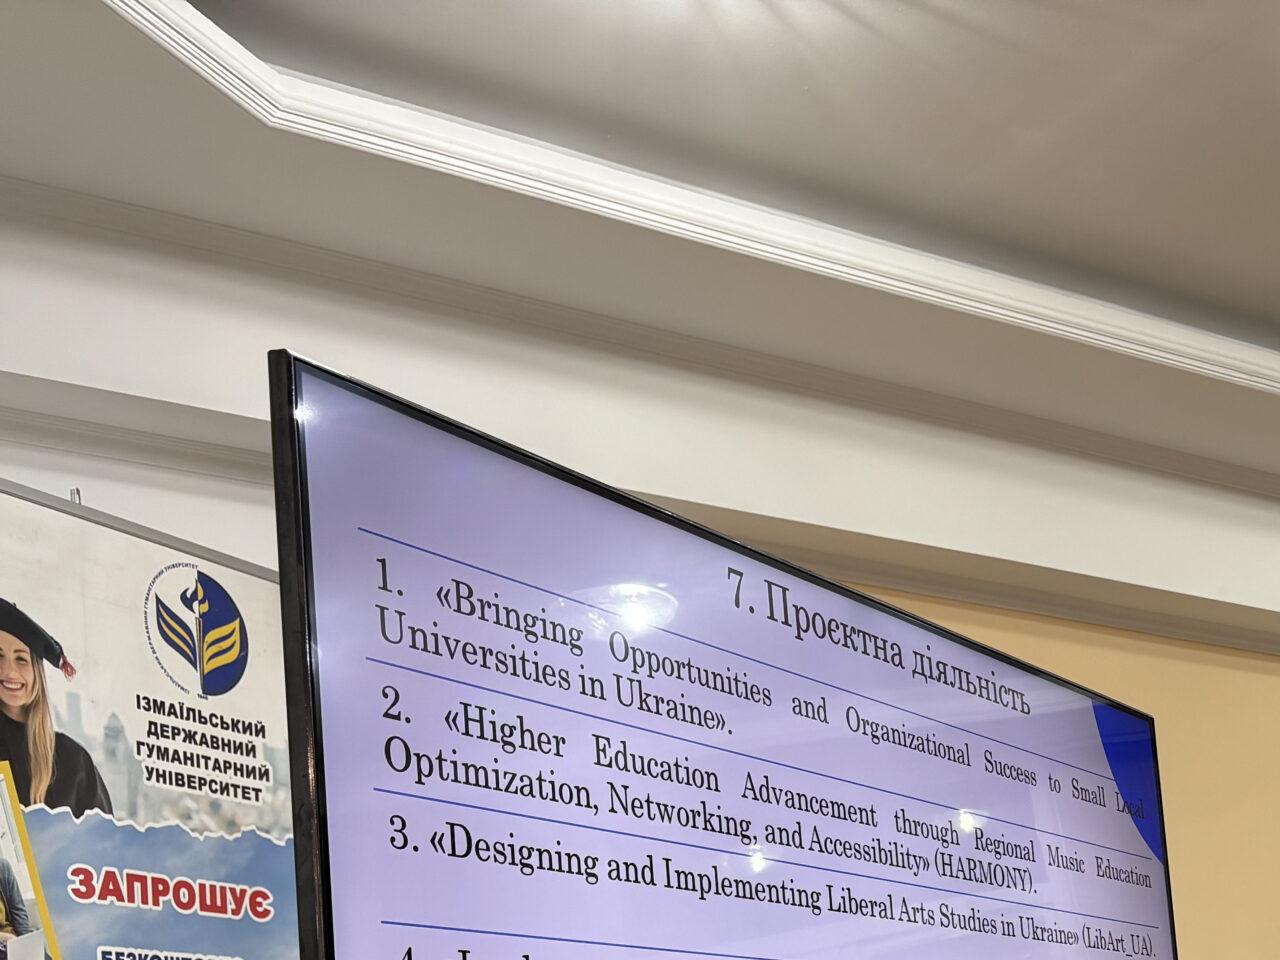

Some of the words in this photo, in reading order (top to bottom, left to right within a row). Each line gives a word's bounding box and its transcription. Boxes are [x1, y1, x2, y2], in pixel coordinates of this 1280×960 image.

[376, 604, 571, 691] Universities
[579, 664, 607, 701] in
[613, 672, 733, 735] Ukraine».
[376, 558, 404, 596] 1.
[436, 578, 584, 656] «Bringing
[609, 630, 773, 707] Opportunities
[791, 695, 829, 725] and
[846, 704, 971, 768] Organizational
[984, 749, 1037, 787] Success
[1048, 772, 1061, 794] to
[1071, 778, 1106, 808] Small
[1115, 792, 1145, 819] Local
[727, 566, 755, 614] 7.
[764, 579, 905, 671] Проєктна
[911, 644, 1031, 716] діяльність
[135, 694, 267, 739] ІЗМАЇЛЬСЬКИЙ
[135, 741, 271, 783] ГУМАНІТАРНИЙ
[146, 719, 257, 759] ДЕРЖАВНИЙ
[143, 764, 263, 802] УНІВЕРСИТЕТ
[382, 685, 412, 724] 2.
[444, 701, 566, 758] «Higher
[592, 733, 721, 793] Education
[741, 771, 878, 828] Advancement
[894, 808, 961, 850] through
[974, 826, 1036, 863] Regional
[1047, 844, 1086, 874] Music
[1095, 856, 1152, 889] Education
[384, 735, 599, 815] Optimization,
[607, 781, 759, 847] Networking,
[764, 820, 803, 850] and
[809, 824, 931, 878] Accessibility»
[935, 850, 1038, 895] (HARMONY).
[70, 866, 273, 920] ЗАПРОШУЄ
[389, 814, 419, 853] 3.
[430, 820, 599, 885] «Designing
[607, 855, 656, 886] and
[662, 857, 822, 915] Implementing
[826, 883, 895, 921] Liberal
[898, 902, 936, 928] Arts
[939, 903, 997, 936] Studies
[1001, 913, 1016, 938] in
[1018, 914, 1079, 947] Ukraine»
[1082, 923, 1157, 959] (LibArt_UA).
